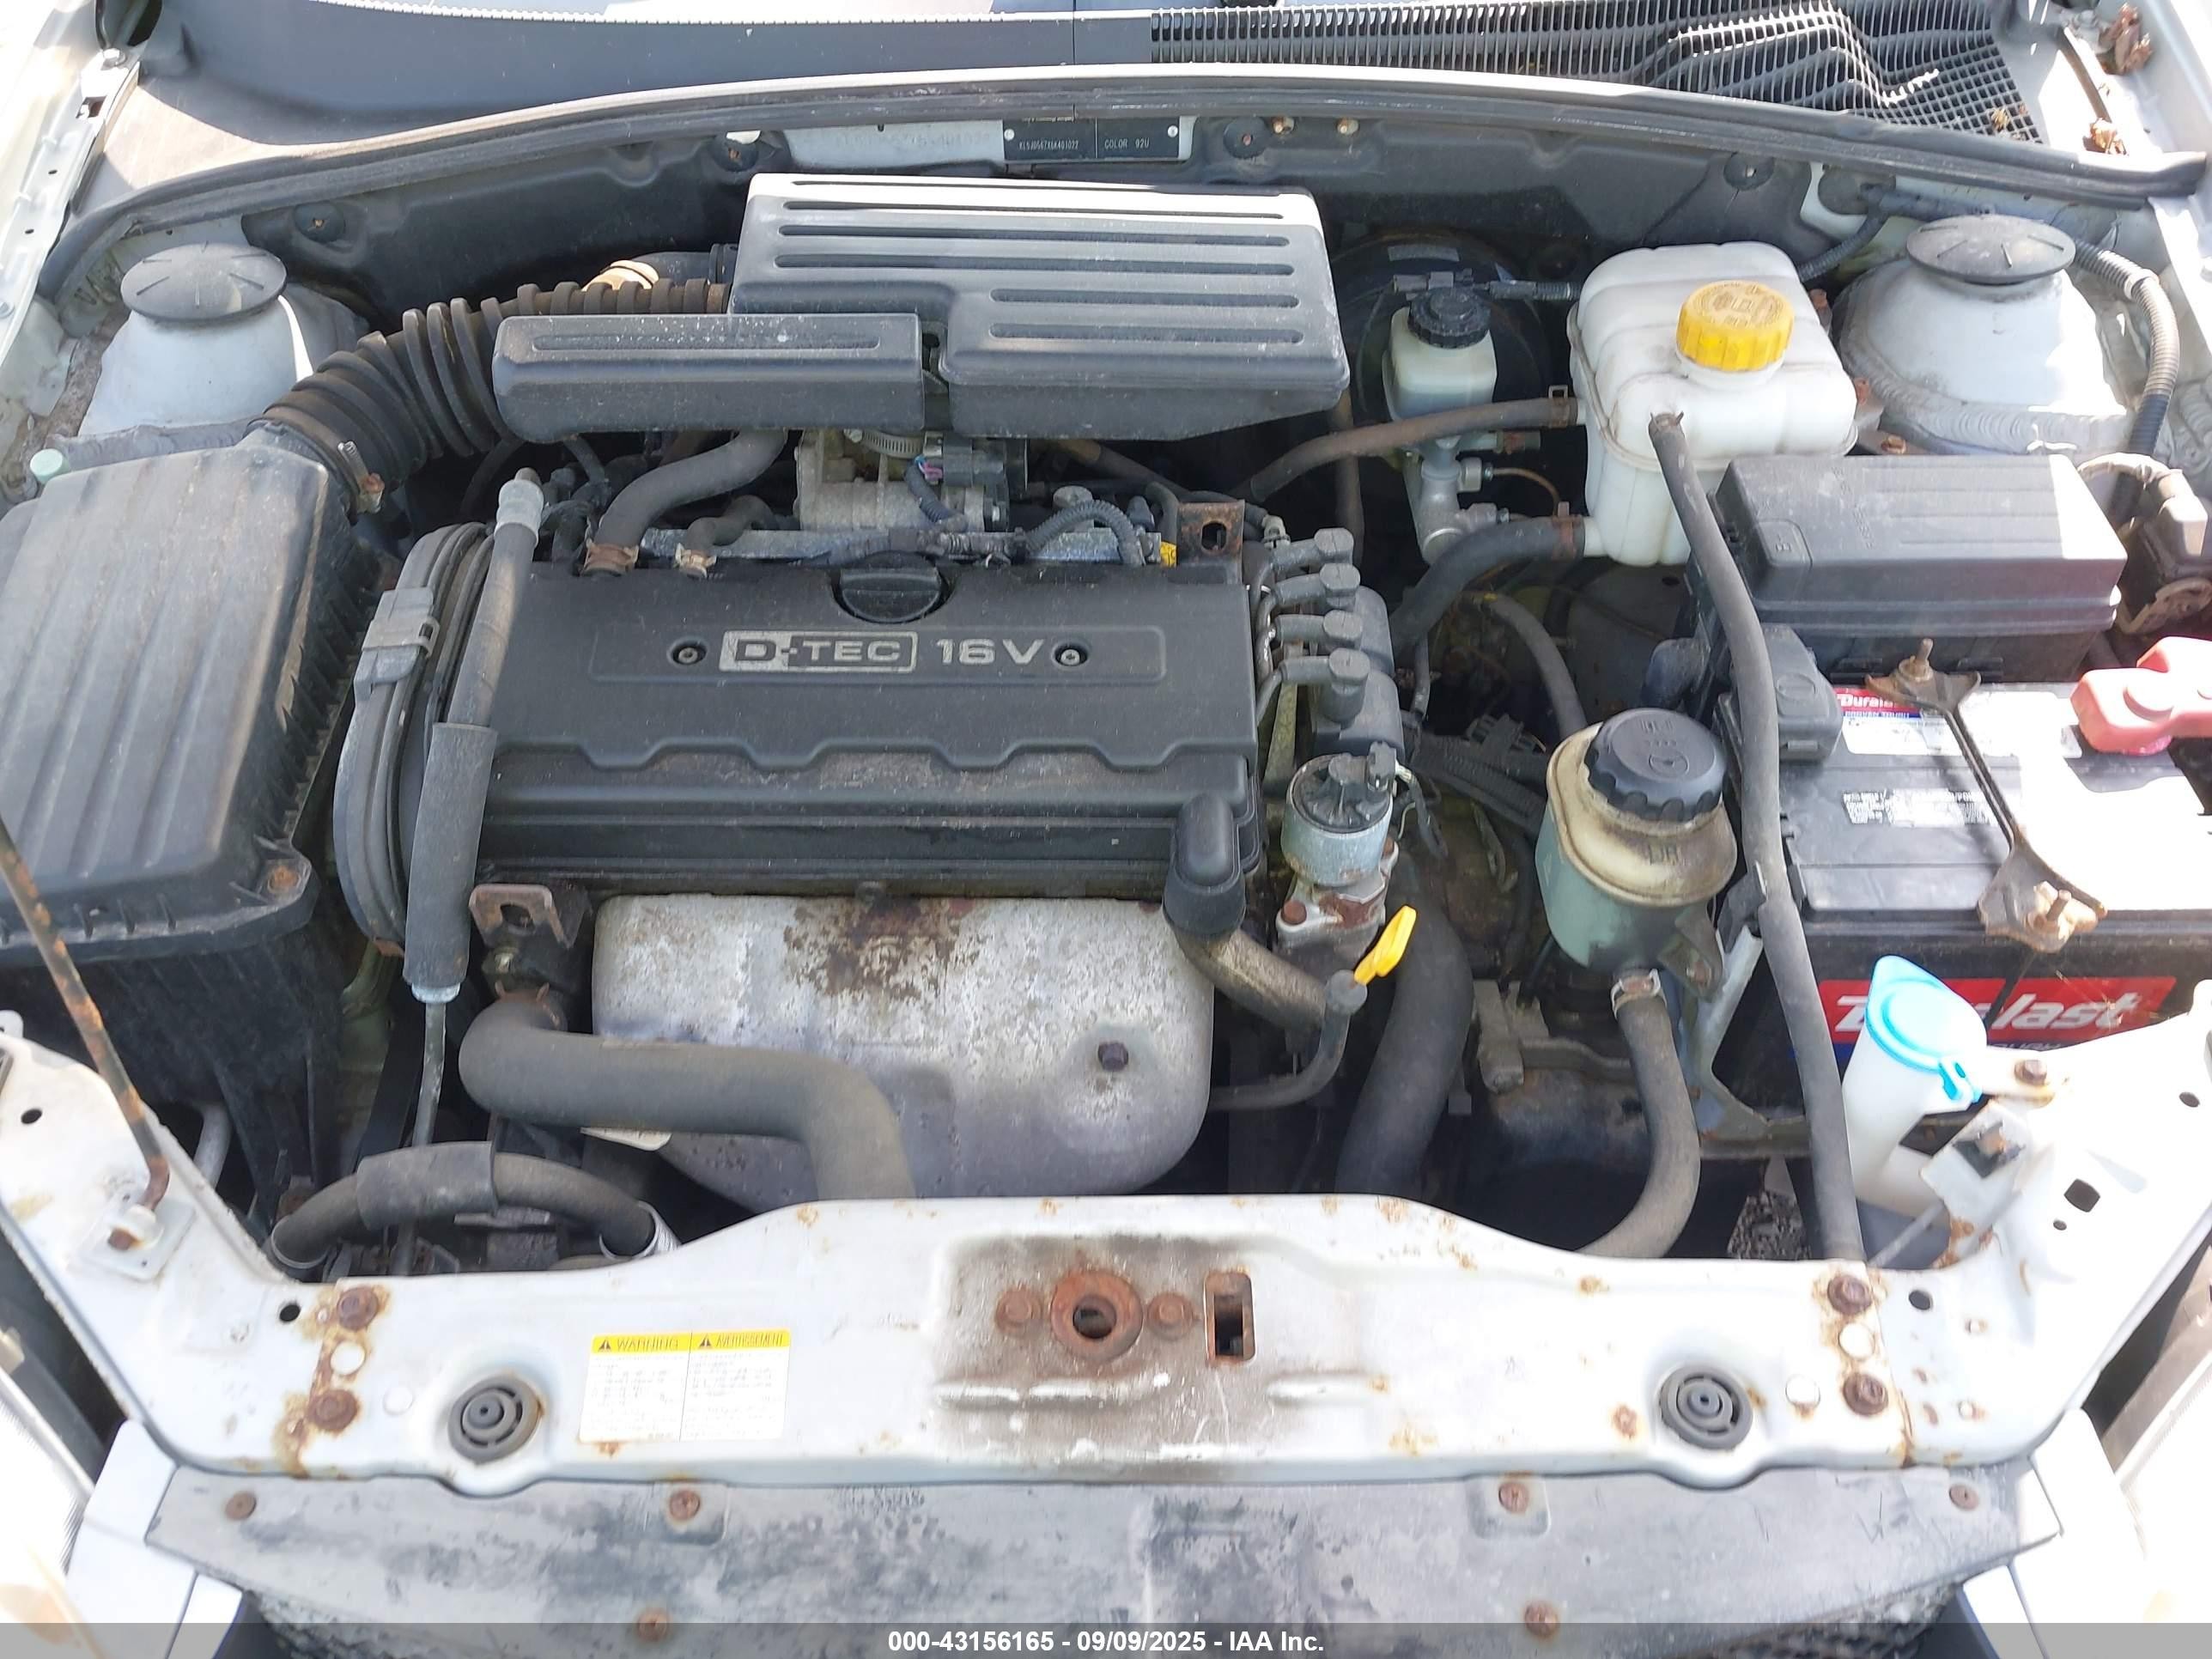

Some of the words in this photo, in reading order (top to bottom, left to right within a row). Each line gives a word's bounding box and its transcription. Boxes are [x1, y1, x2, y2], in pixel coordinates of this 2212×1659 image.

[1104, 139, 1128, 149] COLOR
[1135, 138, 1150, 149] 92U
[734, 638, 902, 663] D-TEC
[936, 639, 1045, 665] 16V
[617, 1339, 679, 1351] WARNING
[716, 1334, 783, 1347] AVERTISSEMENT
